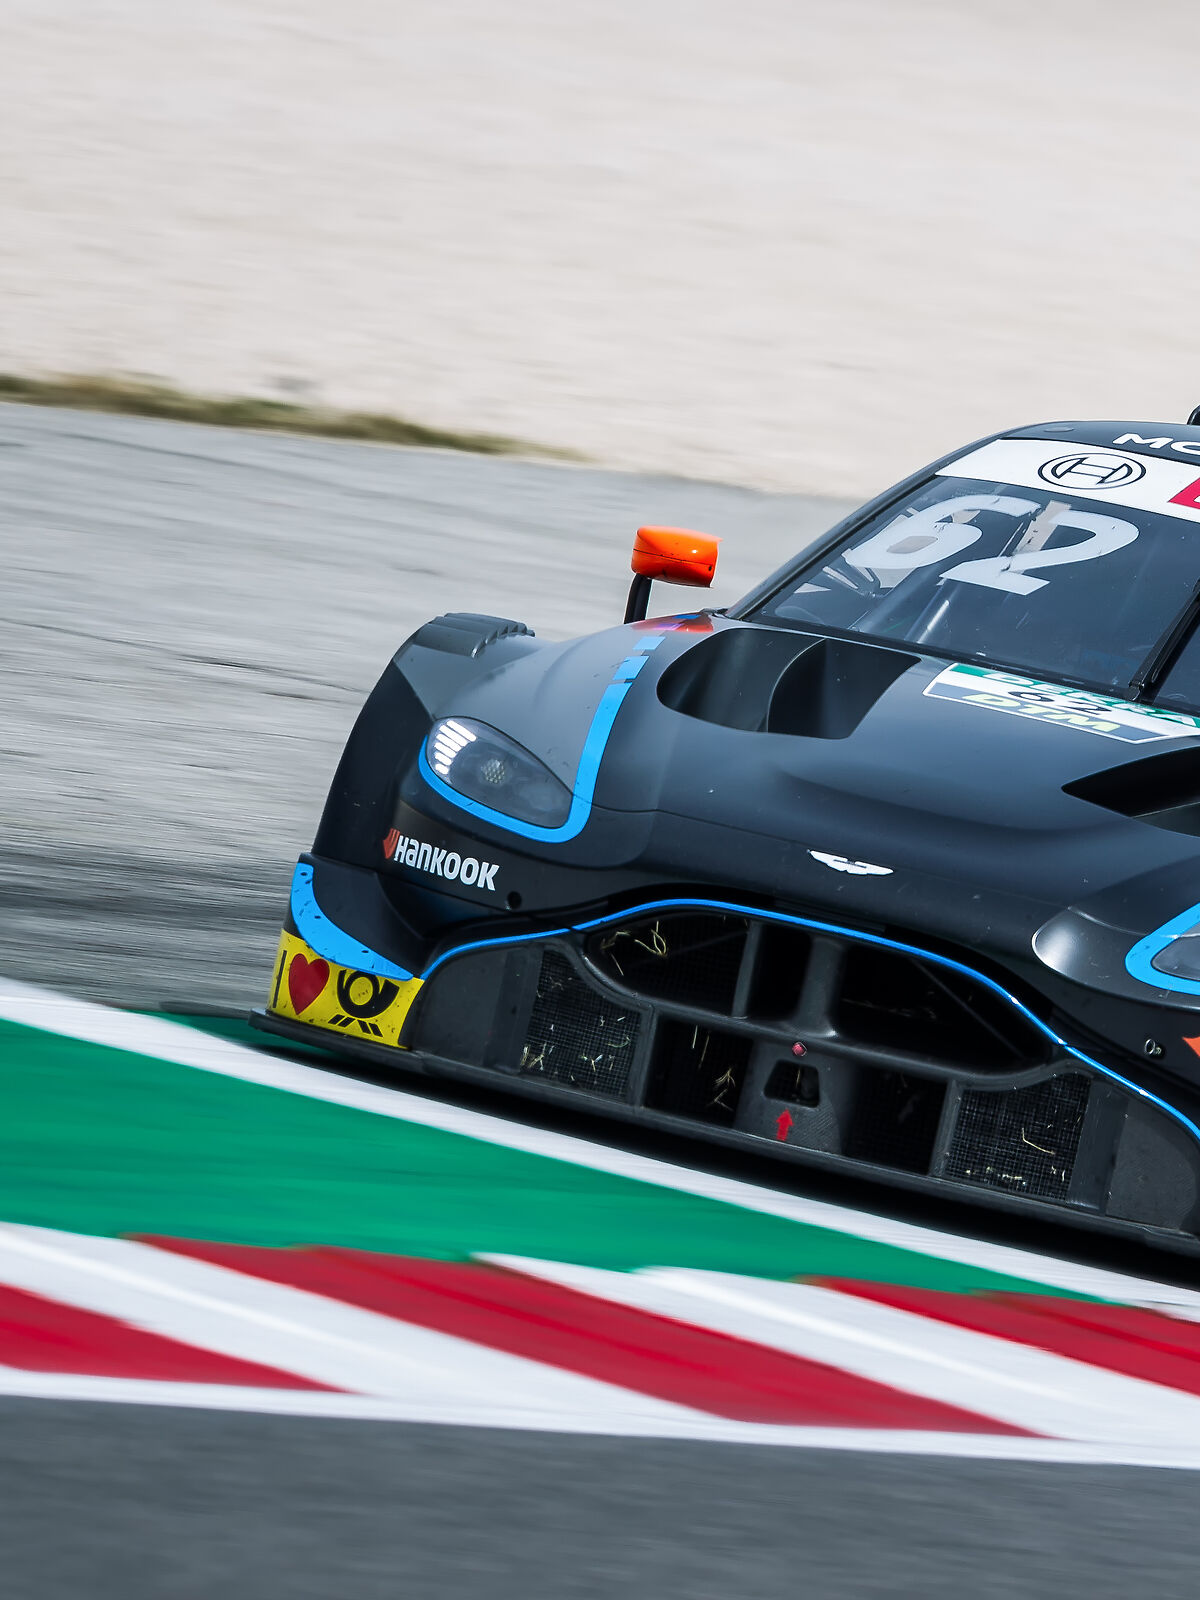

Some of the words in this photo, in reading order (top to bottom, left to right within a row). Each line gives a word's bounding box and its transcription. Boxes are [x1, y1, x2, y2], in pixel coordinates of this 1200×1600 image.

[843, 494, 1140, 596] 62
[962, 693, 1121, 733] DTM
[983, 671, 1197, 727] DEKRA
[1008, 690, 1112, 716] 62
